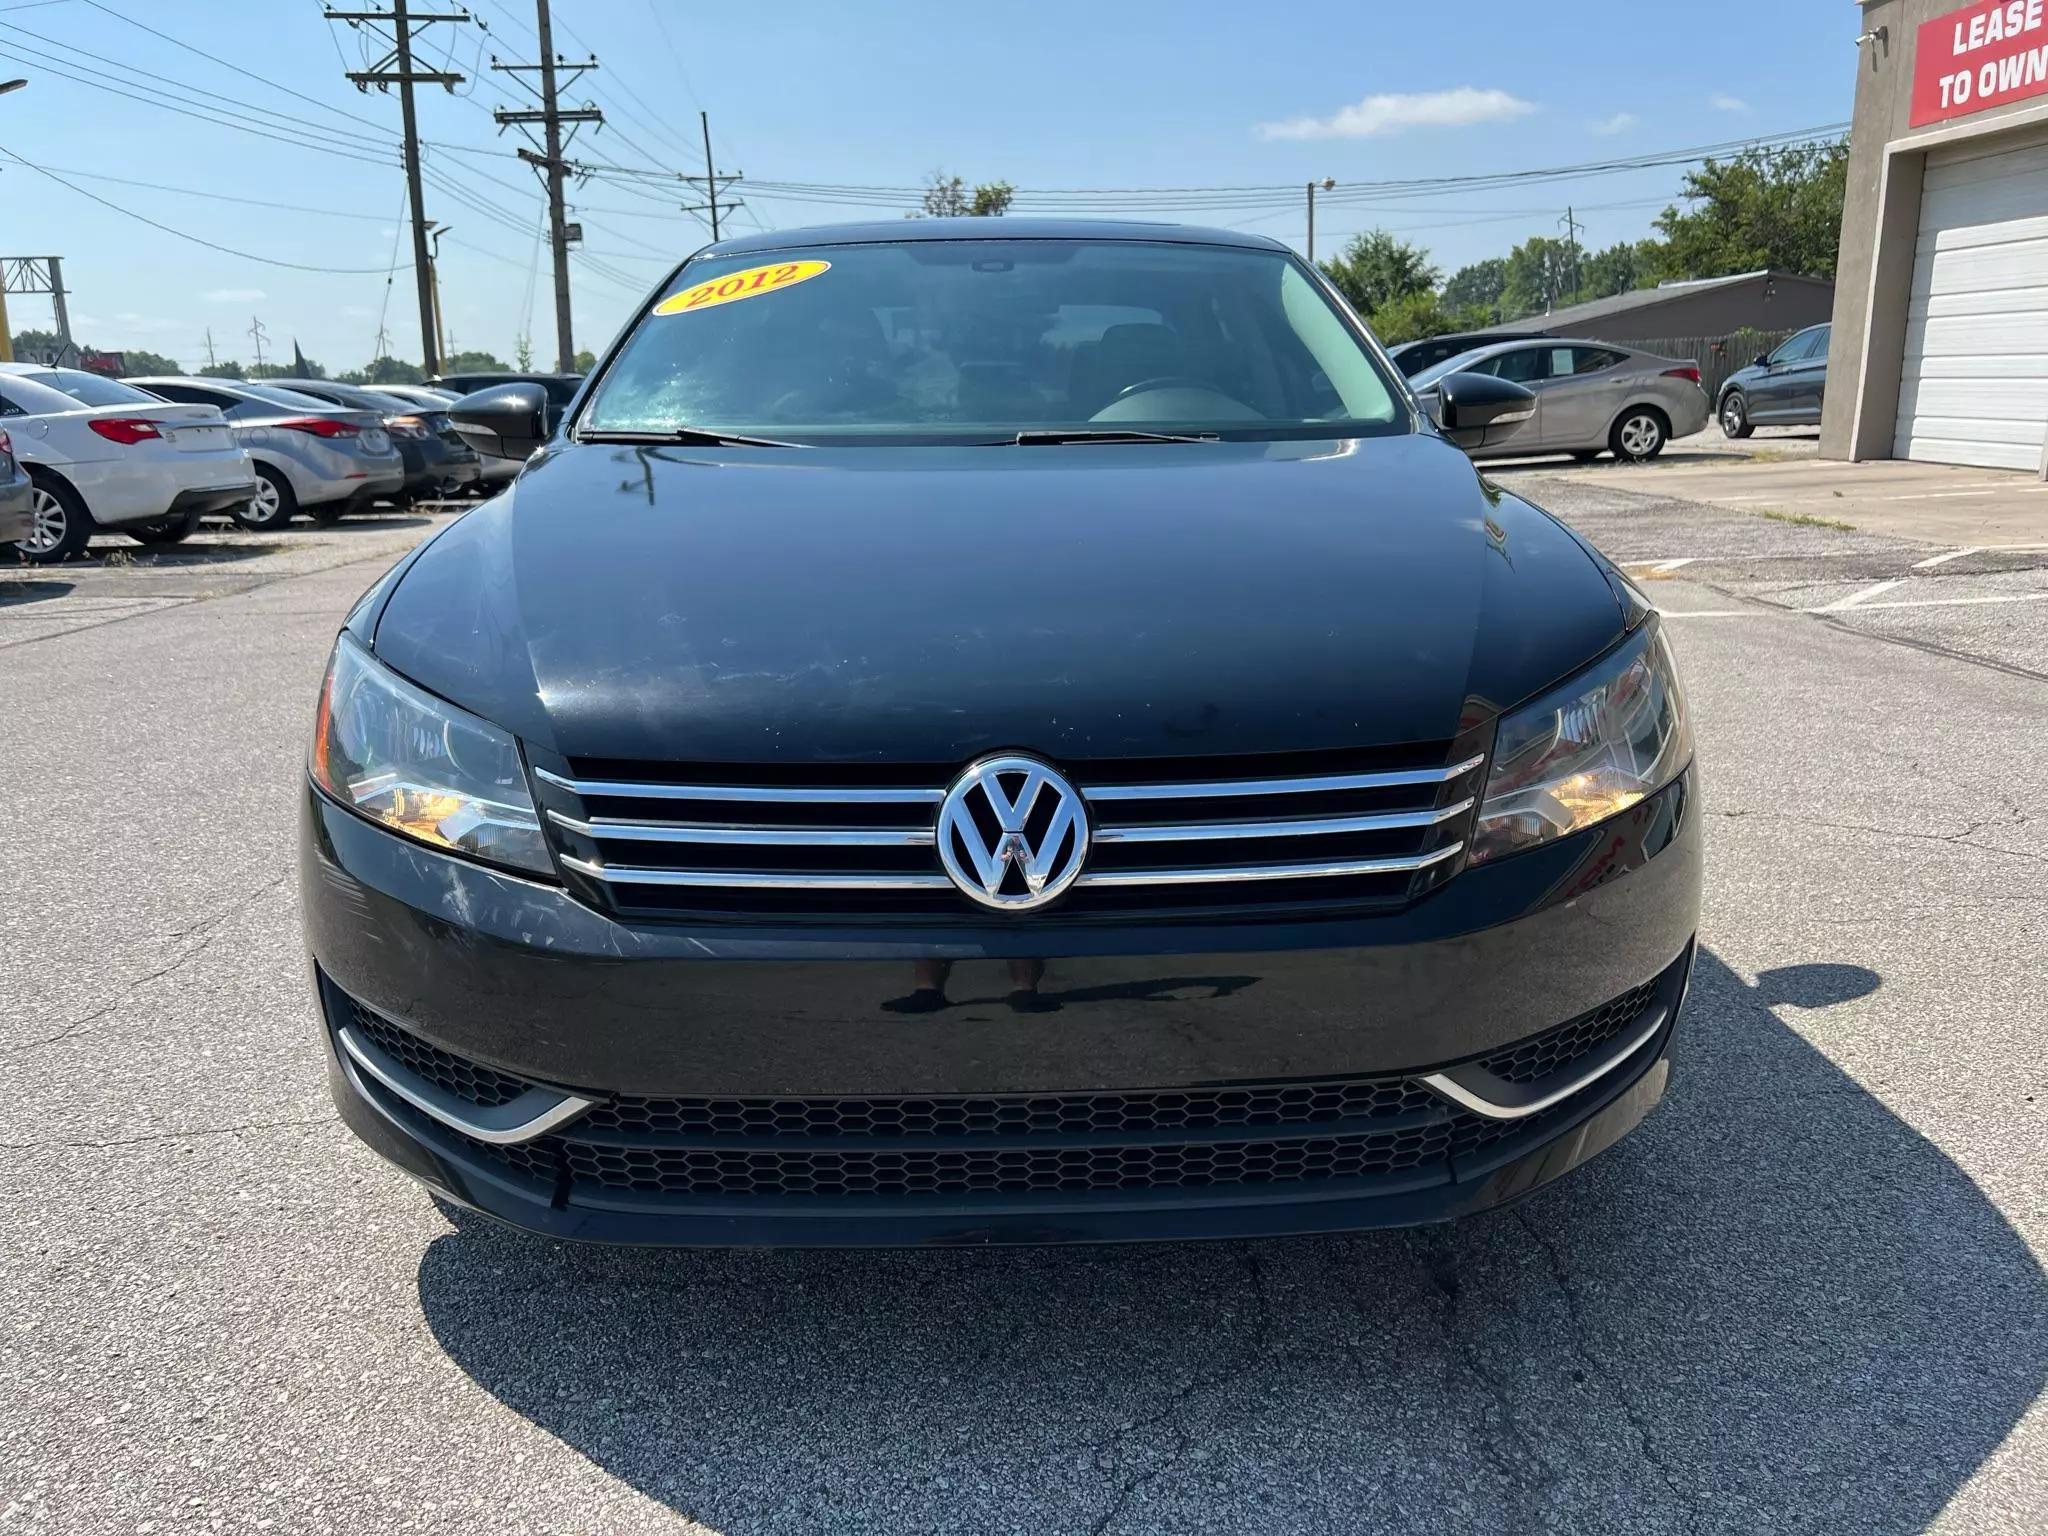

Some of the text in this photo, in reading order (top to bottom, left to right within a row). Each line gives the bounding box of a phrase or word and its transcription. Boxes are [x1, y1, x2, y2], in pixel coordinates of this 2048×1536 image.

[1953, 0, 2044, 56] LEASE
[1939, 44, 2048, 109] TO OWN
[686, 265, 798, 308] 2012
